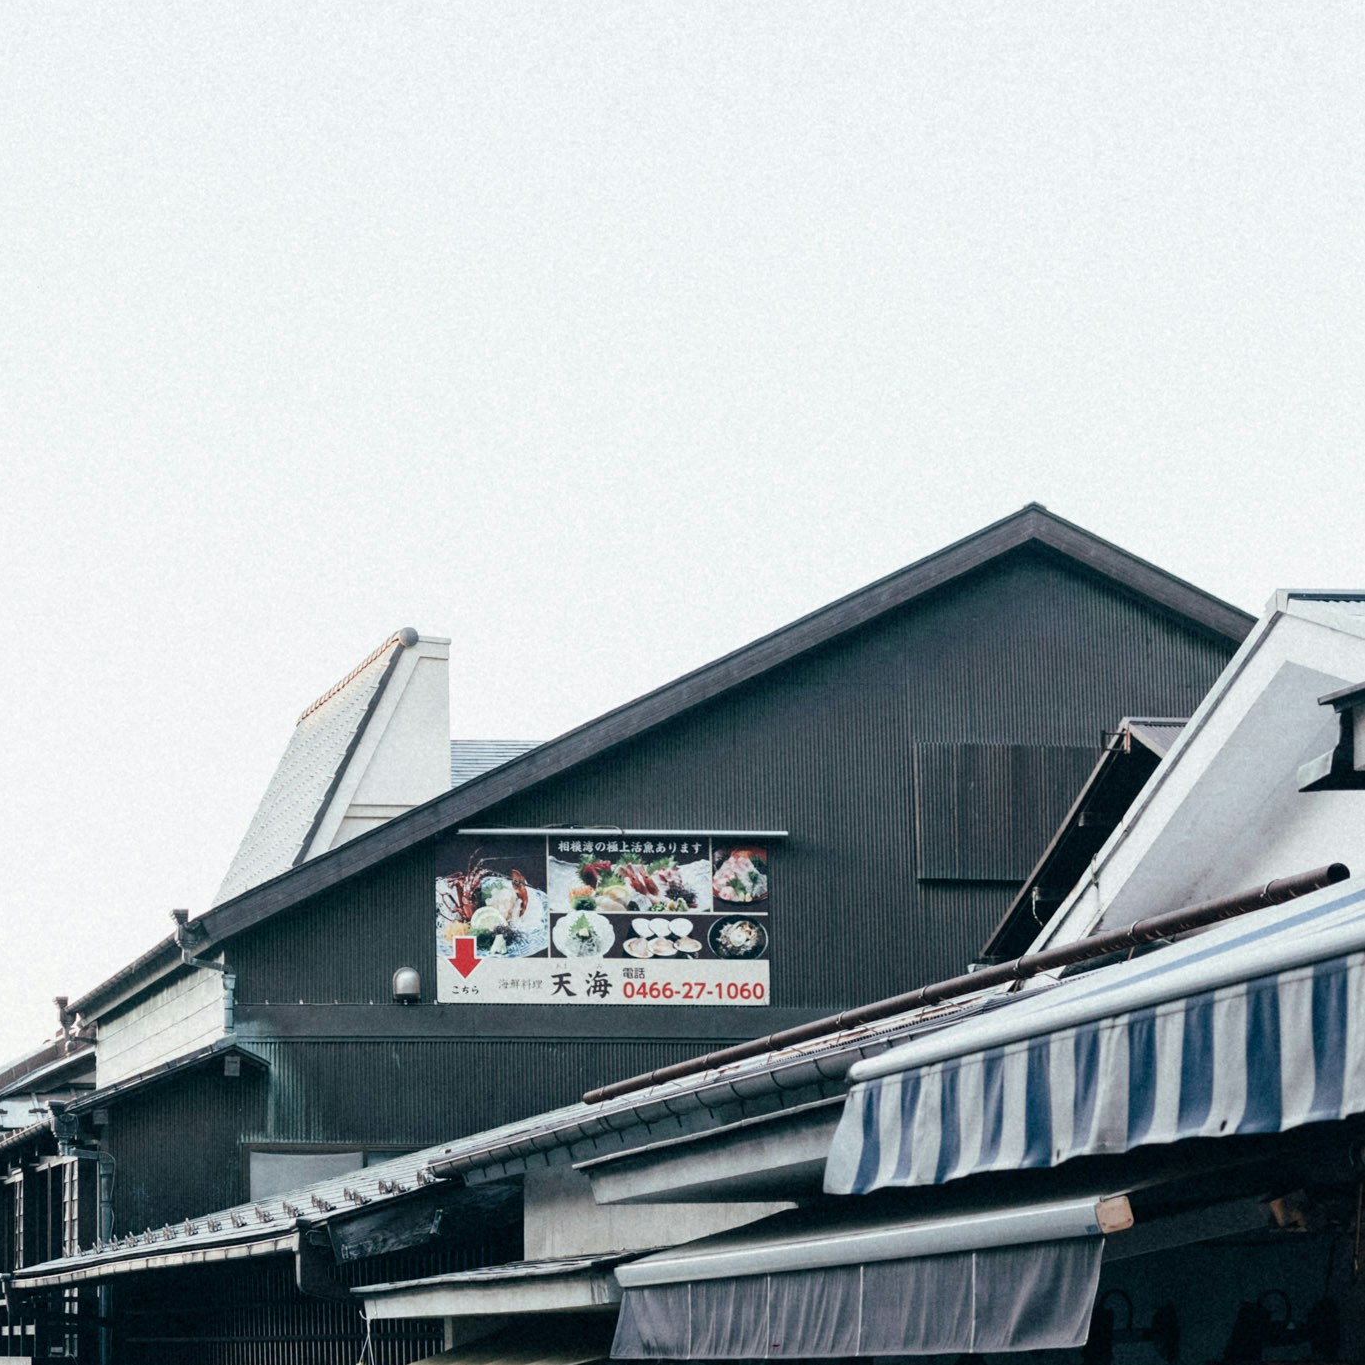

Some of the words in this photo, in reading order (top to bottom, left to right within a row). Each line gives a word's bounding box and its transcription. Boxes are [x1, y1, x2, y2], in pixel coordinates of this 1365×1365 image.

[557, 840, 702, 854] 相模湾の極上活魚あります
[622, 967, 645, 979] 電話
[451, 985, 480, 995] こちら
[498, 978, 543, 990] 海鮮料理
[622, 981, 765, 999] 0466-27-1060
